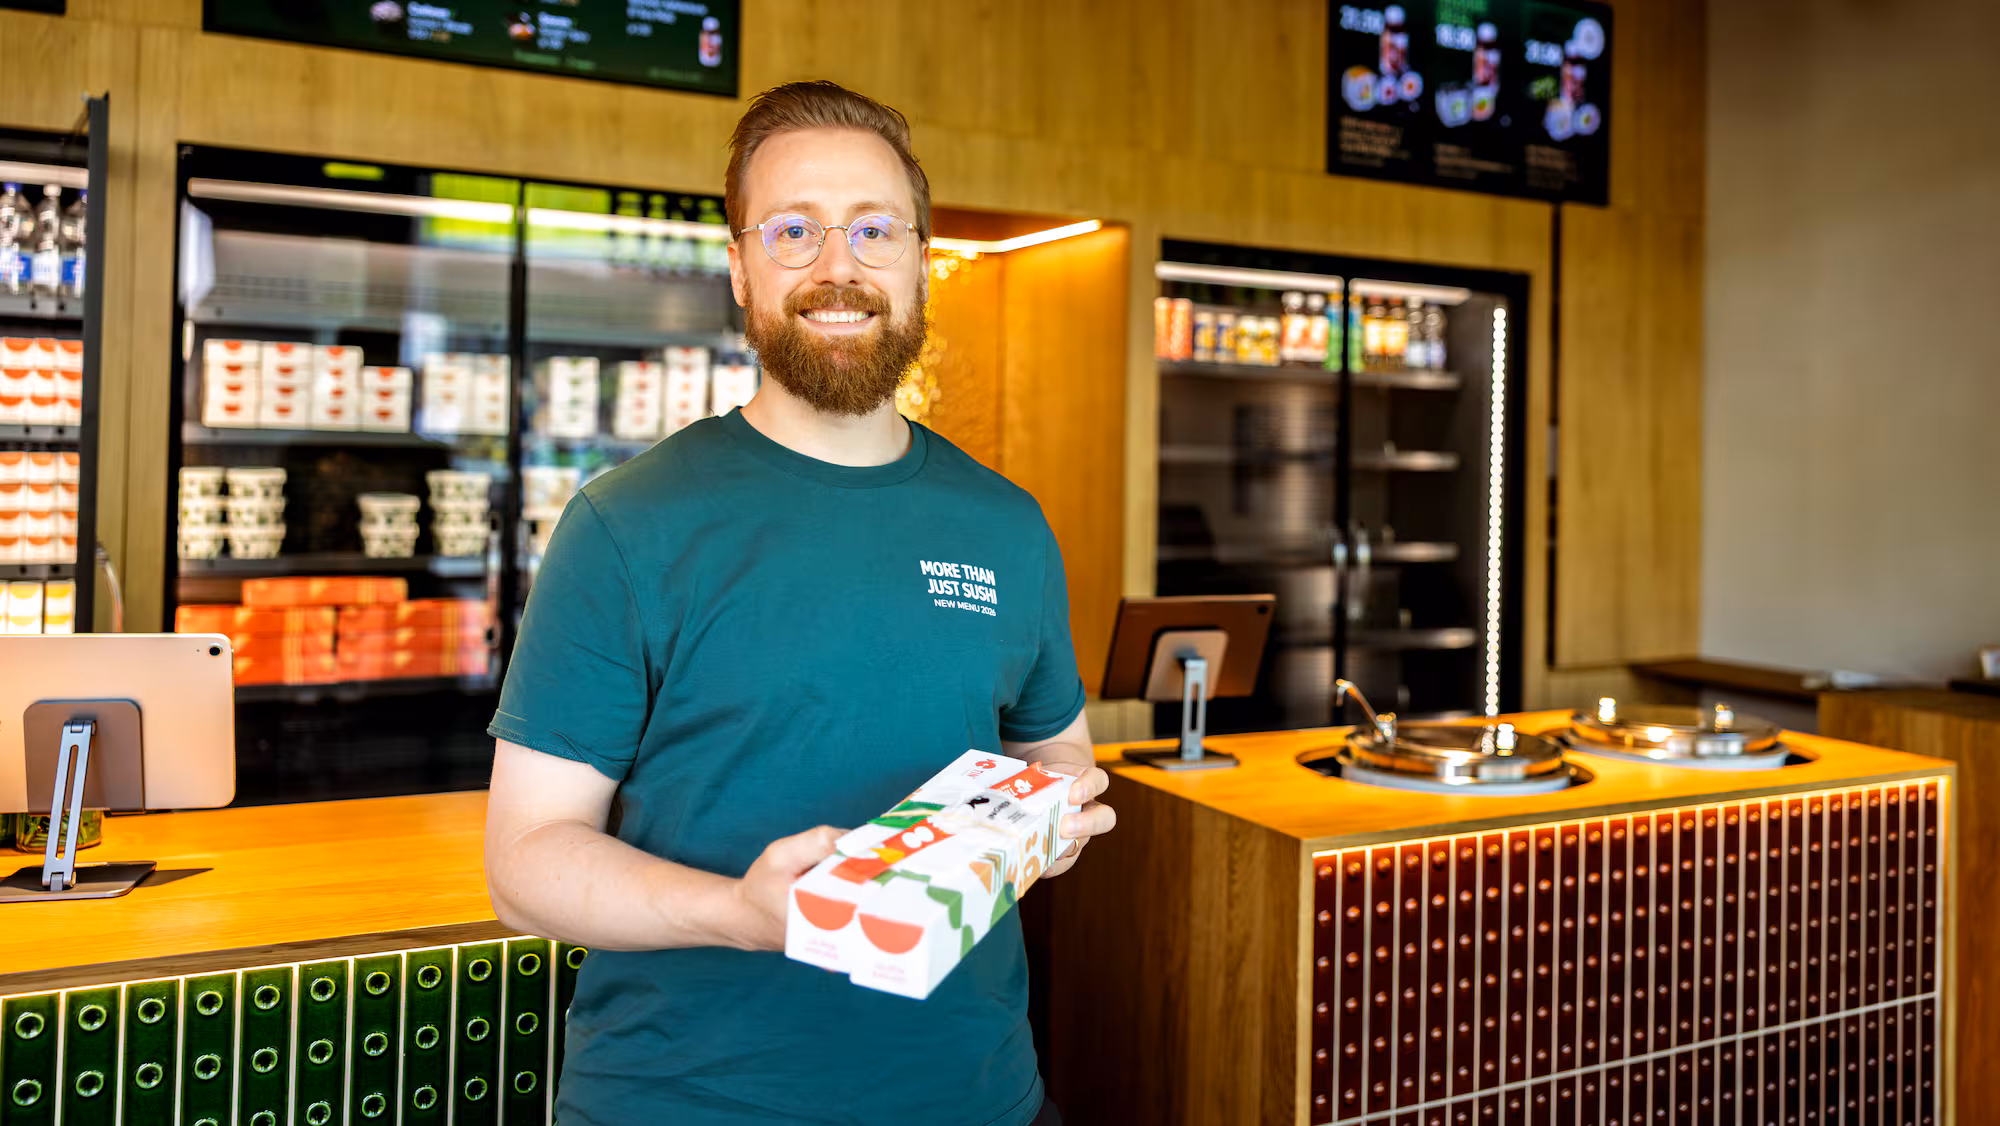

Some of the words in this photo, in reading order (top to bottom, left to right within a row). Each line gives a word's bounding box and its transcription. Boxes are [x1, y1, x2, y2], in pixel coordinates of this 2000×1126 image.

[920, 560, 961, 578] MORE
[961, 564, 996, 586] THAN
[928, 579, 960, 596] JUST
[962, 582, 997, 604] SUSHI
[934, 599, 955, 608] NEW
[957, 601, 980, 612] MENU
[980, 606, 996, 616] 2026
